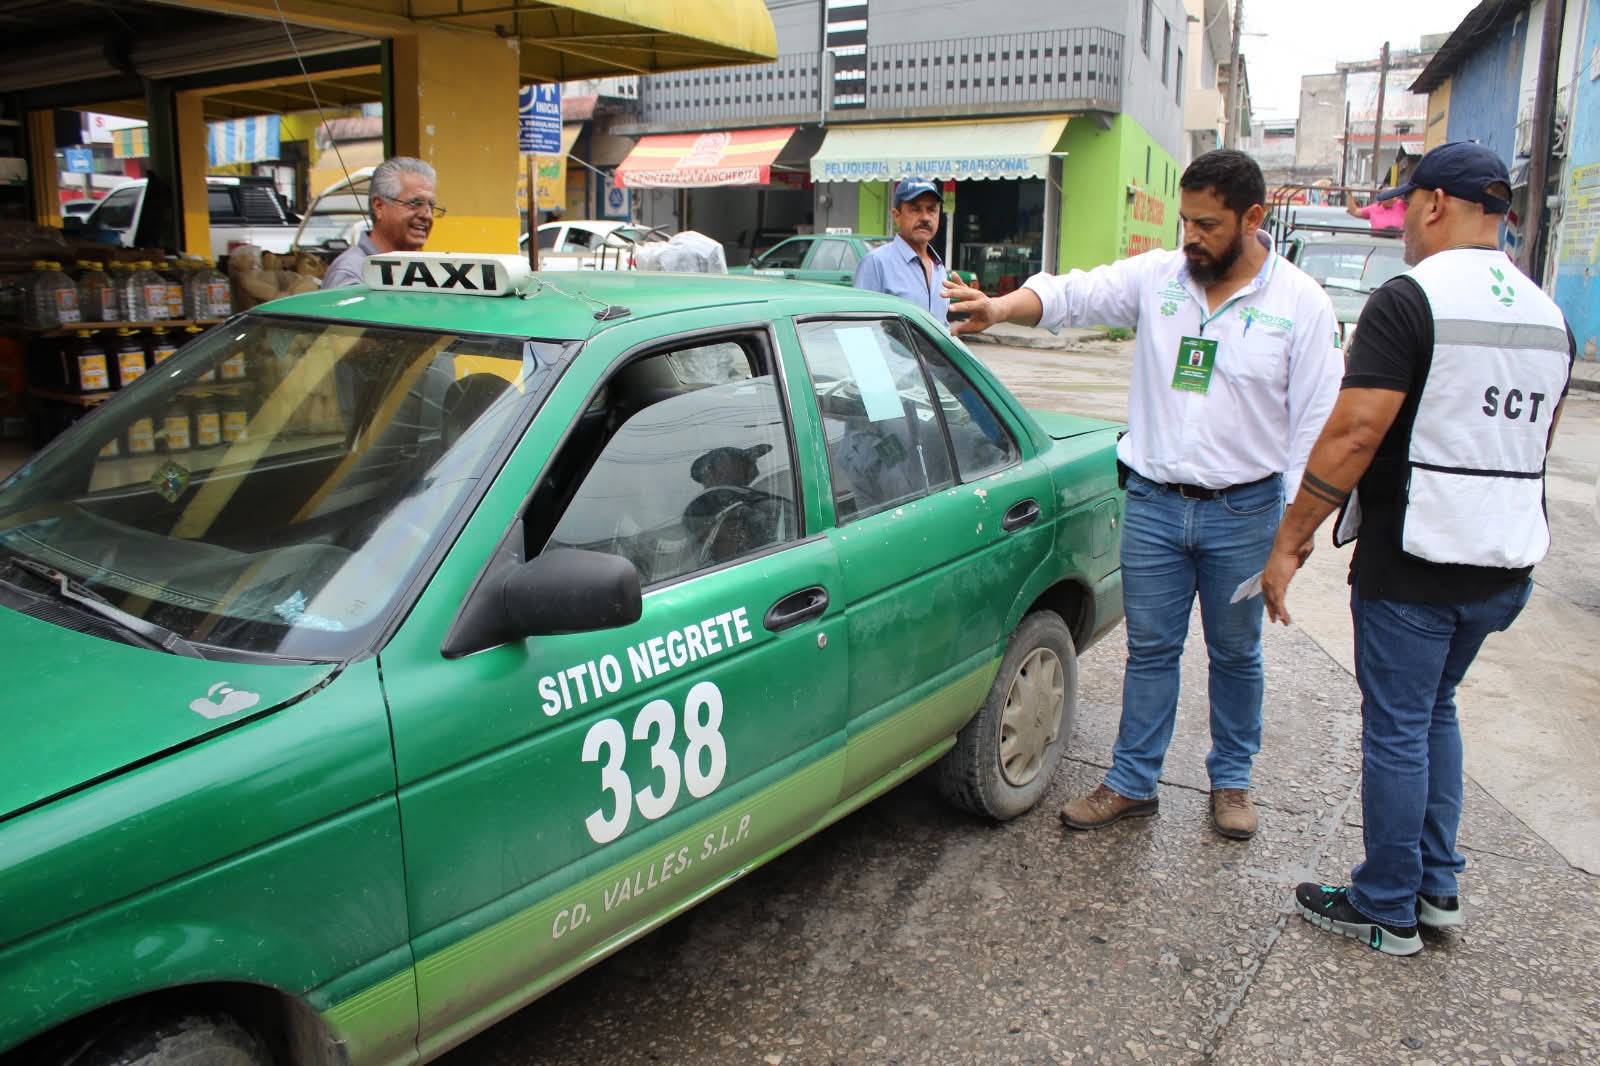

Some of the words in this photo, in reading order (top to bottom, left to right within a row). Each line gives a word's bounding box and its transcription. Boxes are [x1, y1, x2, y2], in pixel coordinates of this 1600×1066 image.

[535, 101, 560, 115] INICIA
[899, 159, 911, 173] LA
[914, 158, 953, 173] NUEVA
[370, 260, 498, 291] TAXI
[1482, 385, 1546, 423] SCT
[537, 654, 623, 719] SITIO
[626, 606, 753, 684] NEGRETE
[581, 681, 728, 845] 338
[551, 903, 592, 939] CD.
